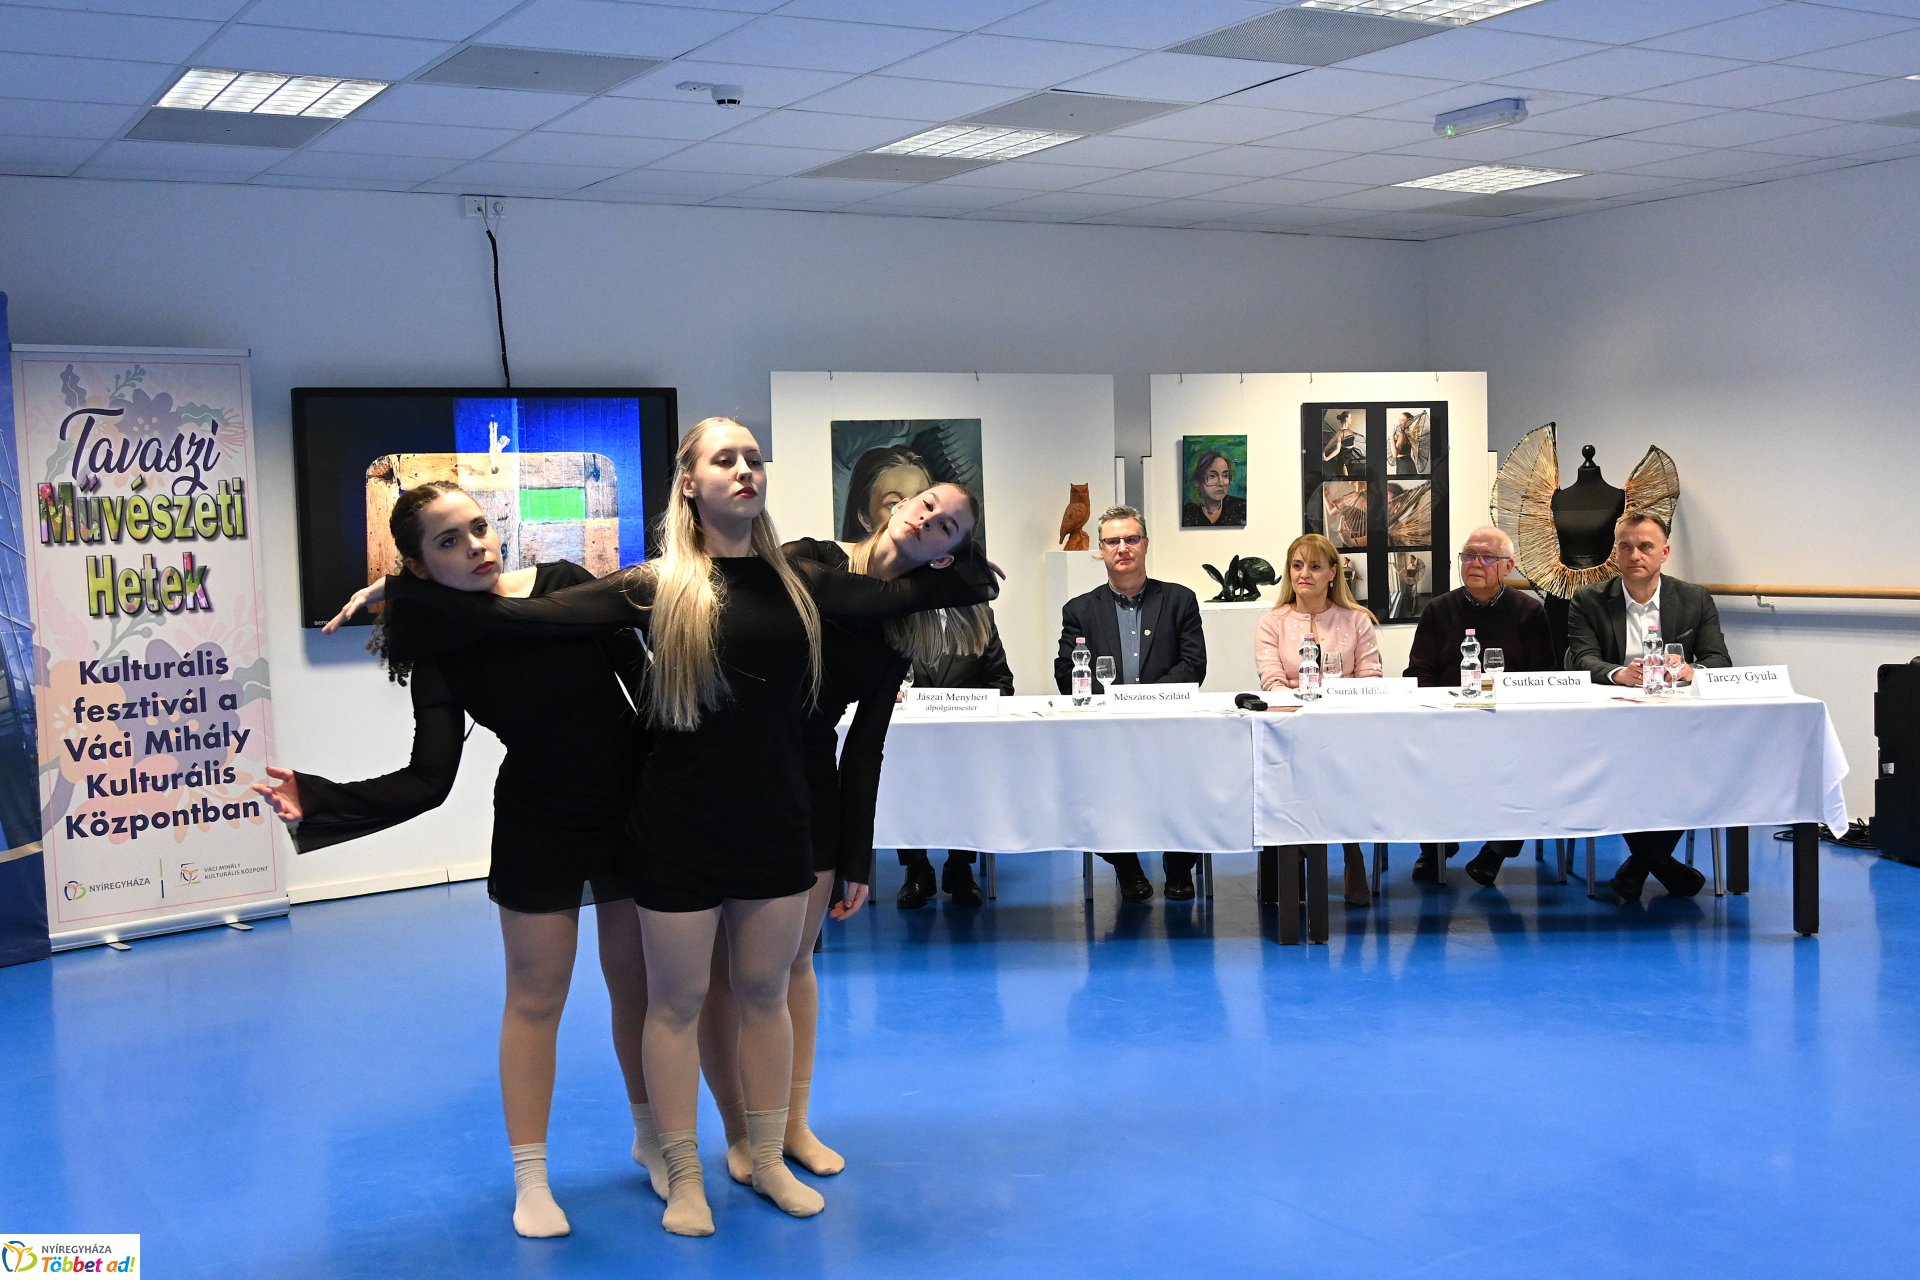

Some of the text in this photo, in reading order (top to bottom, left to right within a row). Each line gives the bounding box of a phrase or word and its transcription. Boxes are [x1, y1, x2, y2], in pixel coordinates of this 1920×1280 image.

[59, 407, 221, 496] Tavaszi
[37, 474, 246, 544] Művészeti
[86, 551, 211, 616] Hetek
[79, 650, 229, 685] Kulturális
[1502, 676, 1581, 687] Csutkai Csaba
[1705, 669, 1778, 684] Tarczy Gyula
[73, 687, 238, 723] fesztivál a
[916, 692, 988, 702] Jászai Menyhért
[925, 704, 978, 713] alpolgármester
[1114, 691, 1191, 702] Mészáros Szilárd
[64, 722, 251, 762] Váci Mihály
[86, 760, 237, 799] Kulturális
[65, 797, 260, 840] Központban
[89, 877, 151, 893] NYÍREGYHÁZA
[204, 866, 269, 879] KULTURÁLIS KÖZPONT
